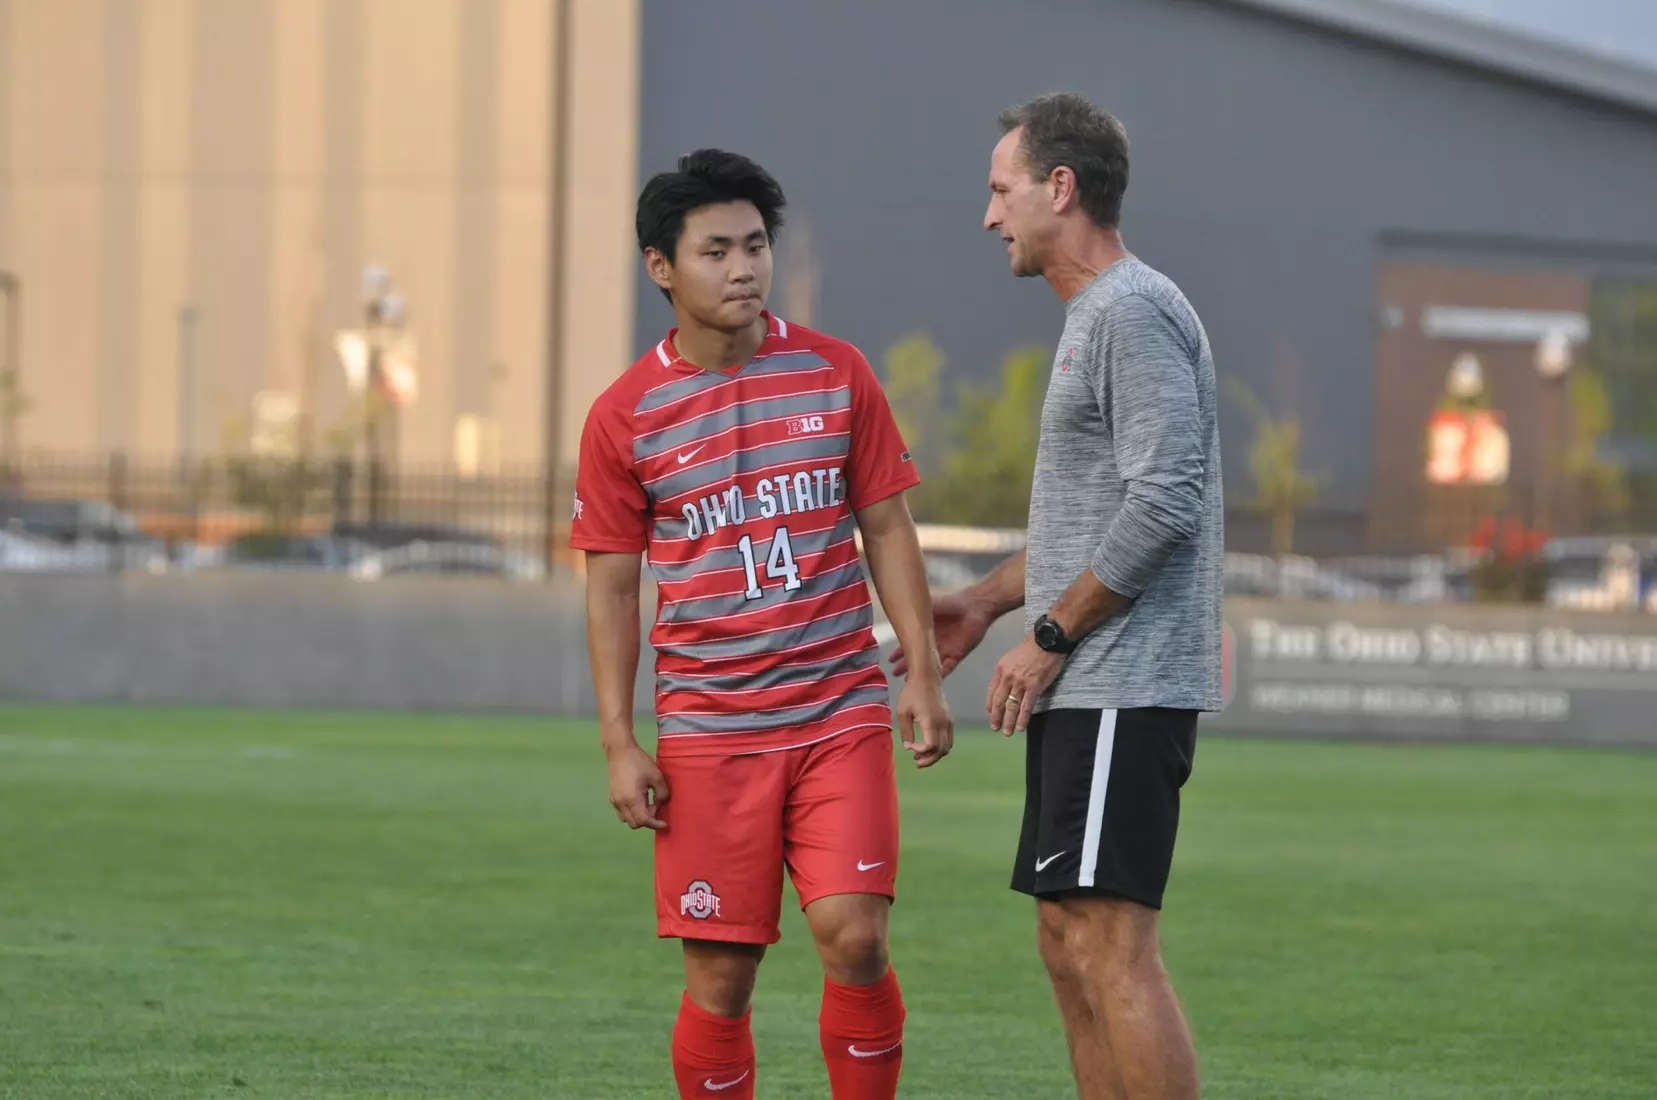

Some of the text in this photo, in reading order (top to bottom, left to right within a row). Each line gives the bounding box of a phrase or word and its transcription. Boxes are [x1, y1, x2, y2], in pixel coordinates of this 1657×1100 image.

[681, 467, 841, 541] OHIO STATE
[737, 526, 803, 600] 14
[1251, 619, 1320, 660] THE
[1327, 621, 1421, 663] OHIO
[1425, 624, 1532, 667] STATE
